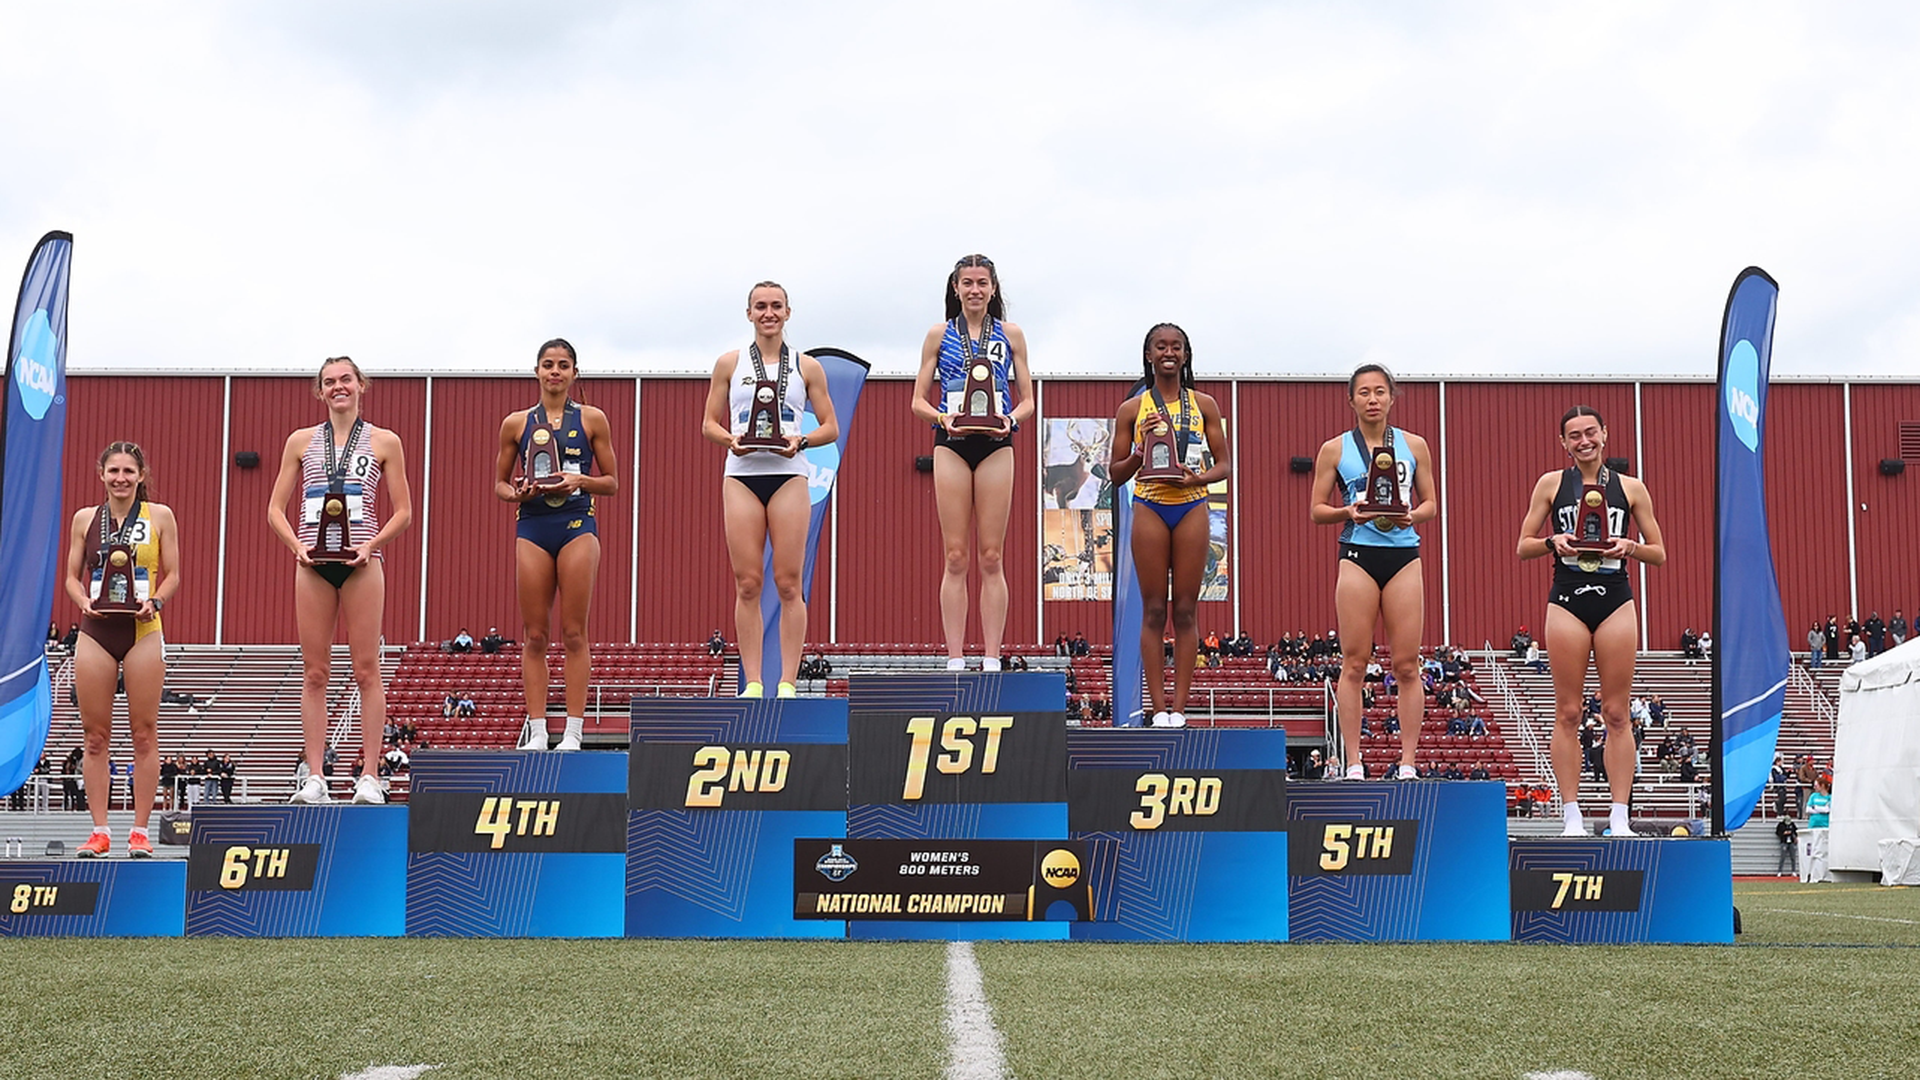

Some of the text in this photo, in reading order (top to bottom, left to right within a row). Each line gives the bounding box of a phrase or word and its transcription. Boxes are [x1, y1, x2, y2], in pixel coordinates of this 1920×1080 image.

[990, 341, 1004, 361] 4
[355, 455, 369, 477] 8
[1397, 461, 1407, 484] 9
[133, 521, 146, 542] 3
[1609, 510, 1618, 535] 1
[1059, 572, 1080, 584] ONLY
[1094, 572, 1113, 584] MIL
[1053, 586, 1084, 598] NORTH
[903, 717, 1014, 800] 1ST
[684, 747, 791, 807] 2ND
[1129, 774, 1223, 830] 3RD
[475, 797, 561, 849] 4TH
[910, 852, 969, 863] WOMEN'S
[1319, 824, 1394, 870] 5TH
[219, 846, 290, 889] 6TH
[899, 865, 980, 876] 800 METERS
[1045, 867, 1078, 879] NCAA
[10, 884, 58, 914] 8TH
[1551, 873, 1604, 909] 7TH
[816, 893, 1005, 914] NATIONAL CHAMPION
